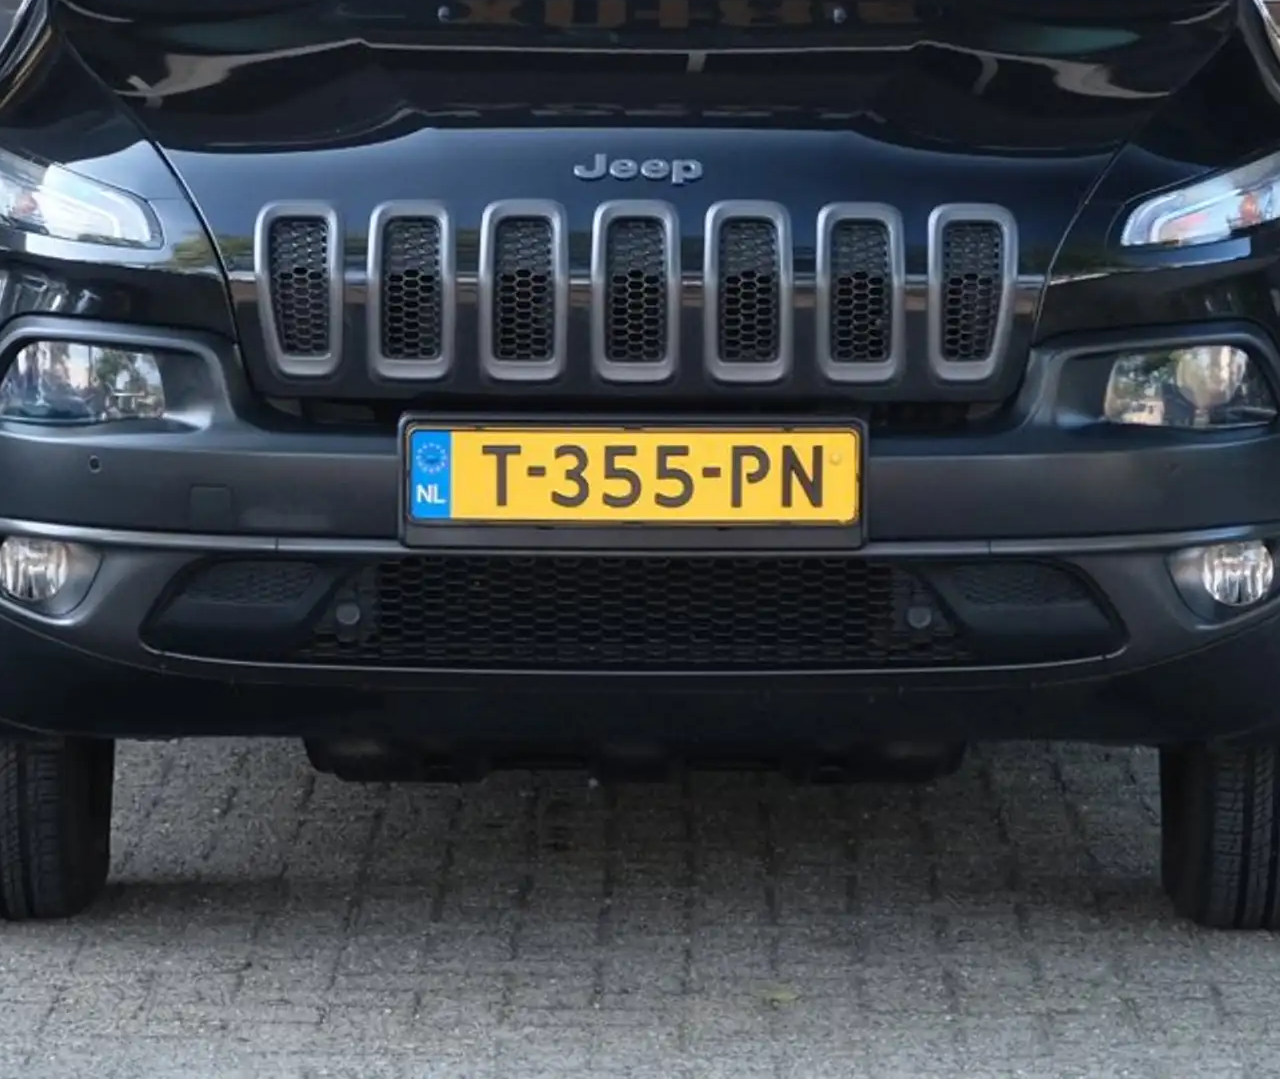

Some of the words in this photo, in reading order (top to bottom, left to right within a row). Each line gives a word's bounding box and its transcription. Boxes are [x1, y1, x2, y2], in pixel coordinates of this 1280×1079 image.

[573, 153, 703, 185] Jeep
[481, 443, 825, 509] T-355-PN
[416, 483, 447, 504] NL
